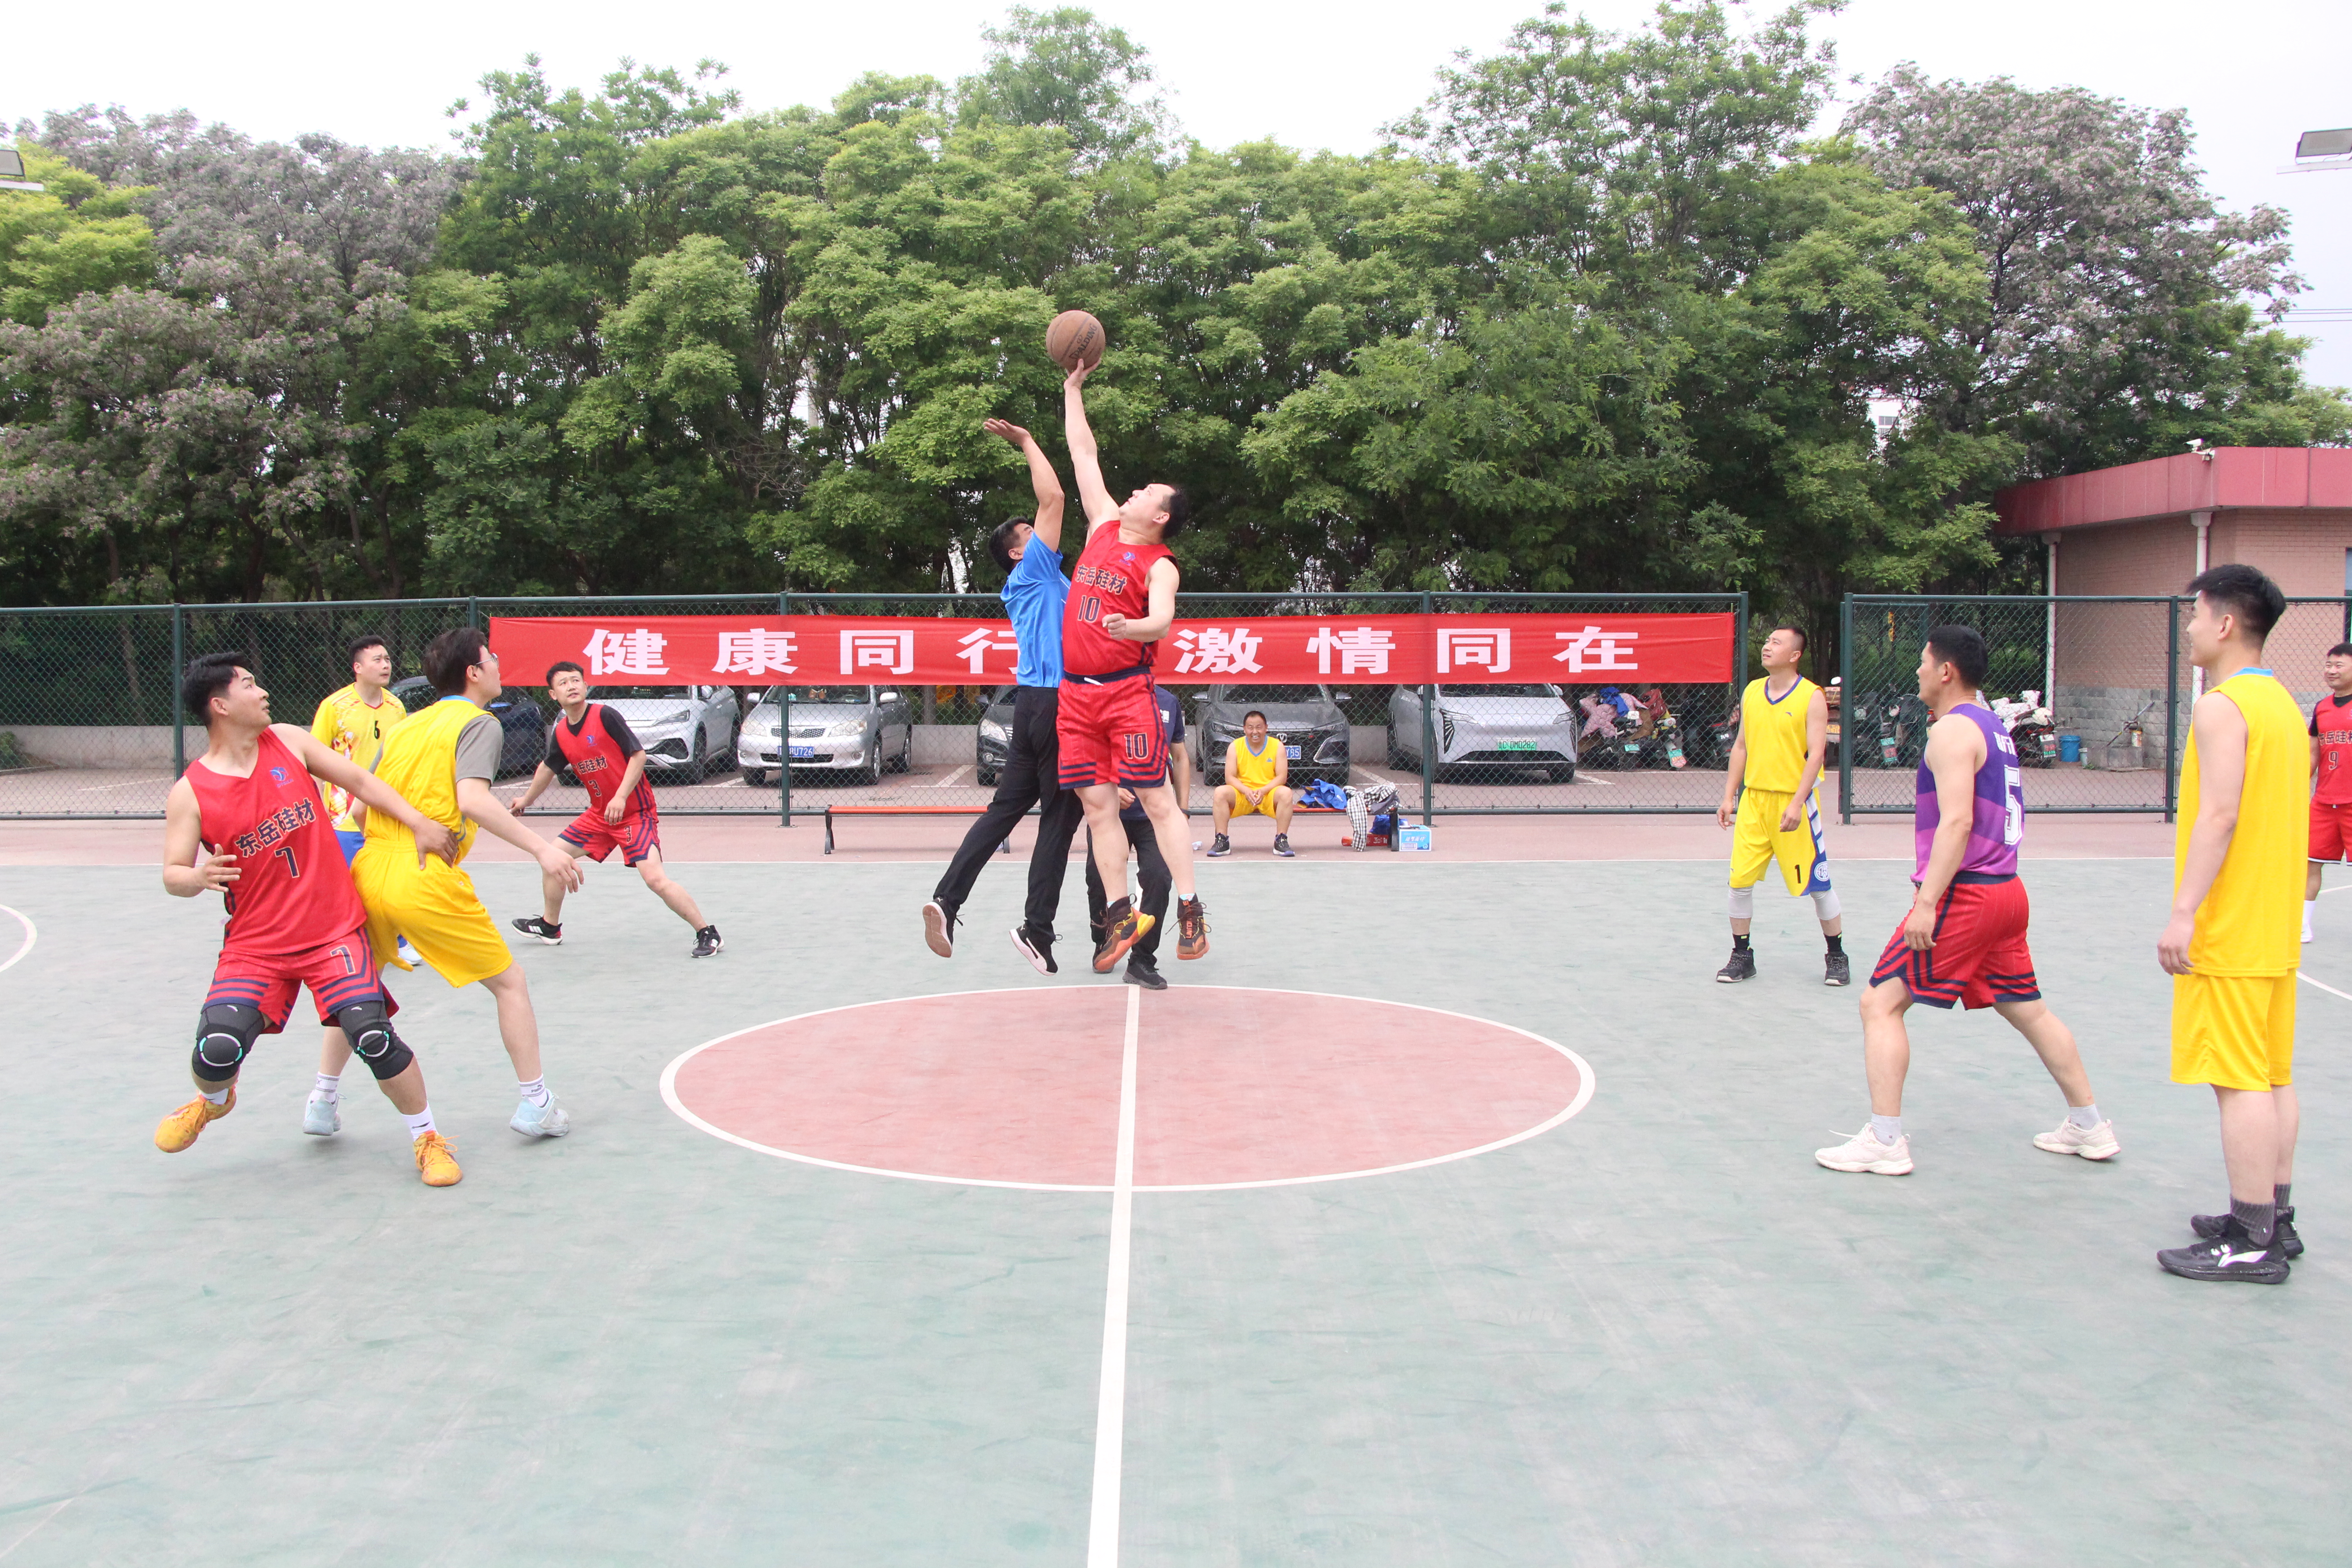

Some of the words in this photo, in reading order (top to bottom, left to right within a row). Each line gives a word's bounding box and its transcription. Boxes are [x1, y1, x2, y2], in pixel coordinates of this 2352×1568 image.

[1074, 564, 1127, 595] 东岳硅材
[1077, 595, 1101, 623] 10
[583, 627, 1021, 675] 健康同行
[1173, 626, 1638, 674] 激情同在
[374, 720, 380, 740] 6
[779, 746, 813, 756] RU726
[1124, 732, 1149, 760] 10
[1286, 748, 1299, 757] Y85
[573, 755, 608, 774] 岳硅材
[2328, 751, 2338, 770] 9
[588, 779, 601, 797] 3
[2004, 764, 2023, 845] 5
[235, 797, 316, 858] 东岳硅材
[623, 825, 632, 843] 3
[274, 846, 300, 878] 7
[1794, 864, 1801, 884] 1
[330, 945, 356, 975] 7
